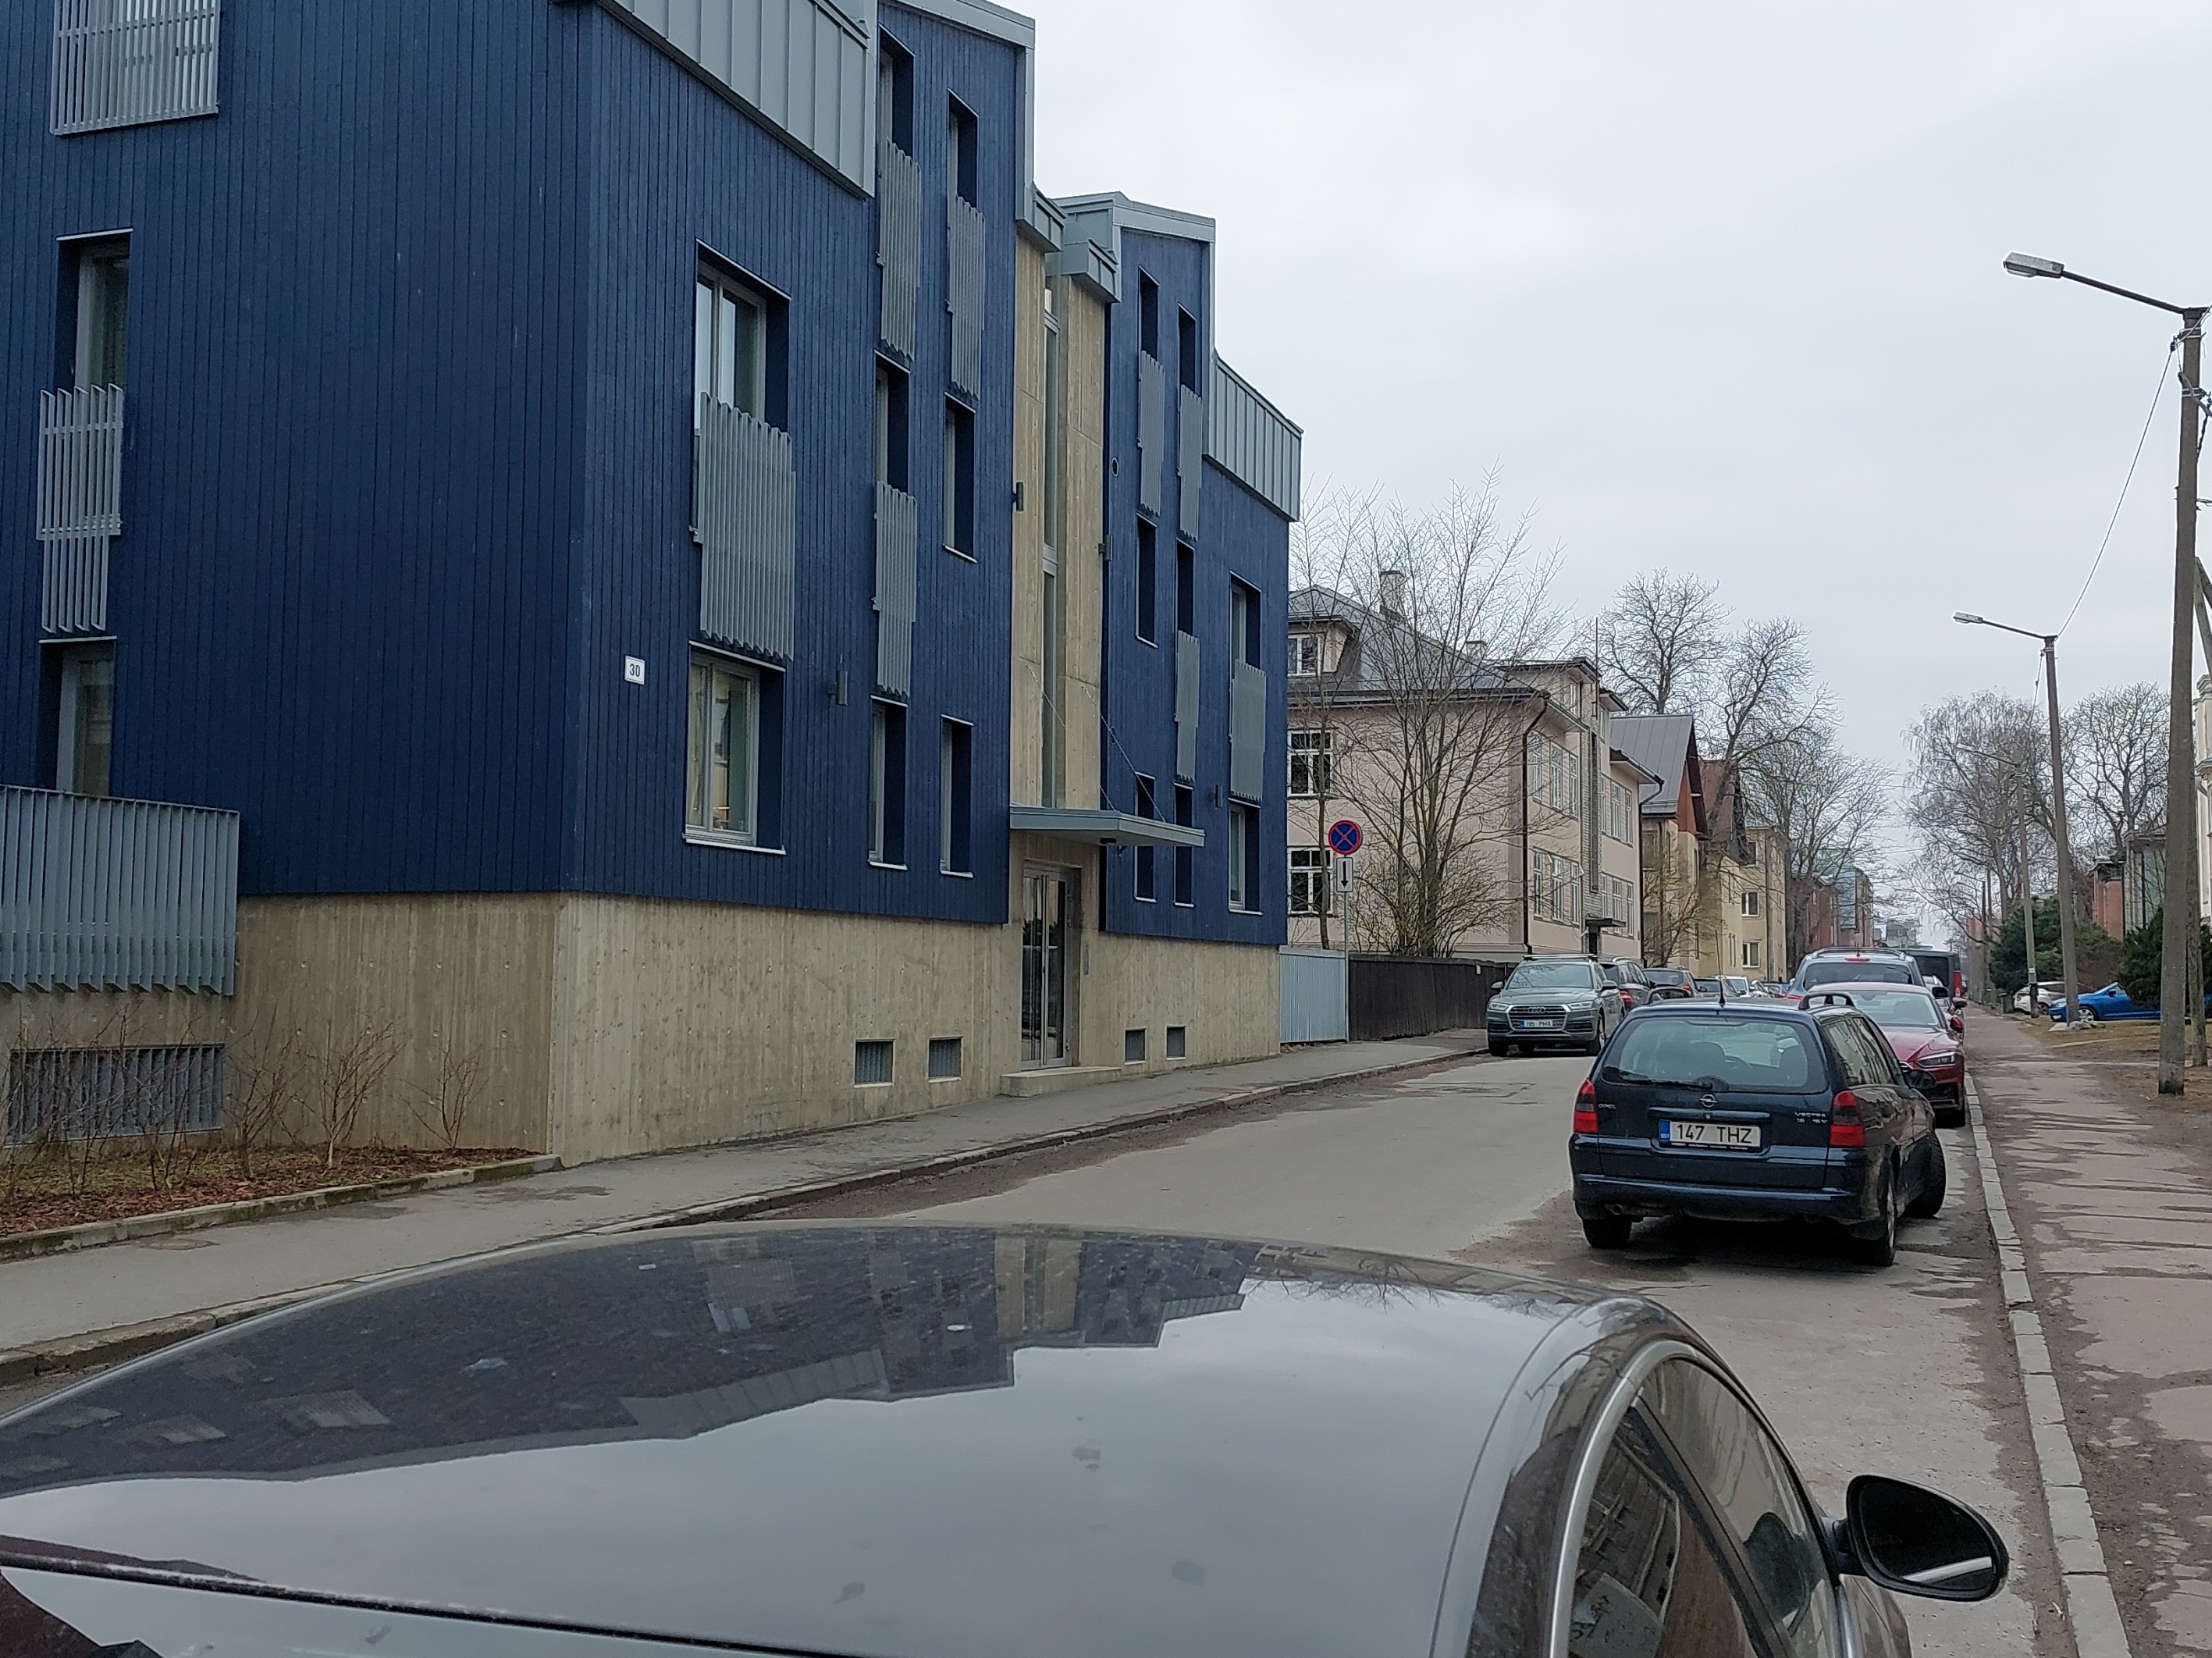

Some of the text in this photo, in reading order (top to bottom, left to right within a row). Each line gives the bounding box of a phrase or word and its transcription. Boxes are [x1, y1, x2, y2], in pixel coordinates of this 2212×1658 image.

[629, 663, 641, 678] 30
[1677, 1123, 1752, 1144] 147 THZ
